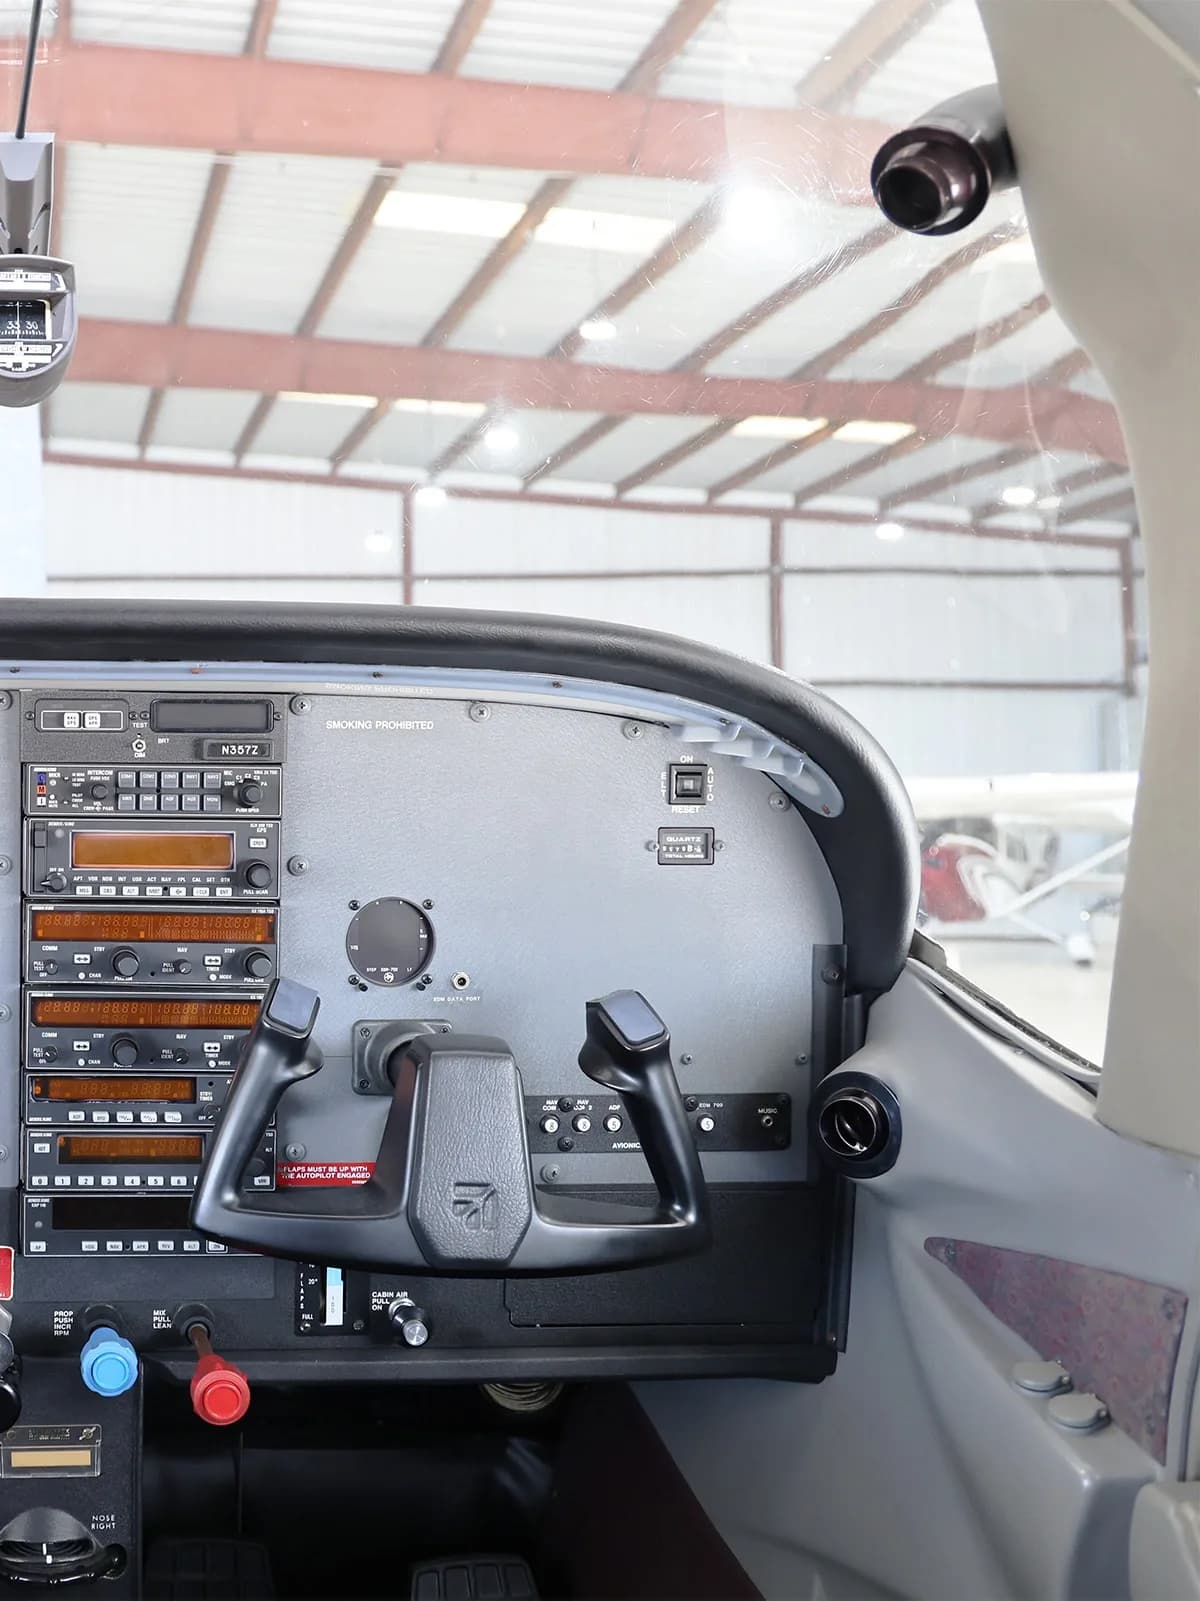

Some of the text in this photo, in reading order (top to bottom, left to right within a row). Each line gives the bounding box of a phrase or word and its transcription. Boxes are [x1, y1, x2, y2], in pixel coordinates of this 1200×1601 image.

[26, 321, 38, 329] 30
[326, 720, 434, 730] SMOKING PROHIBITED
[221, 745, 259, 755] N357Z
[680, 755, 693, 763] ON
[91, 1522, 116, 1530] RIGHT
